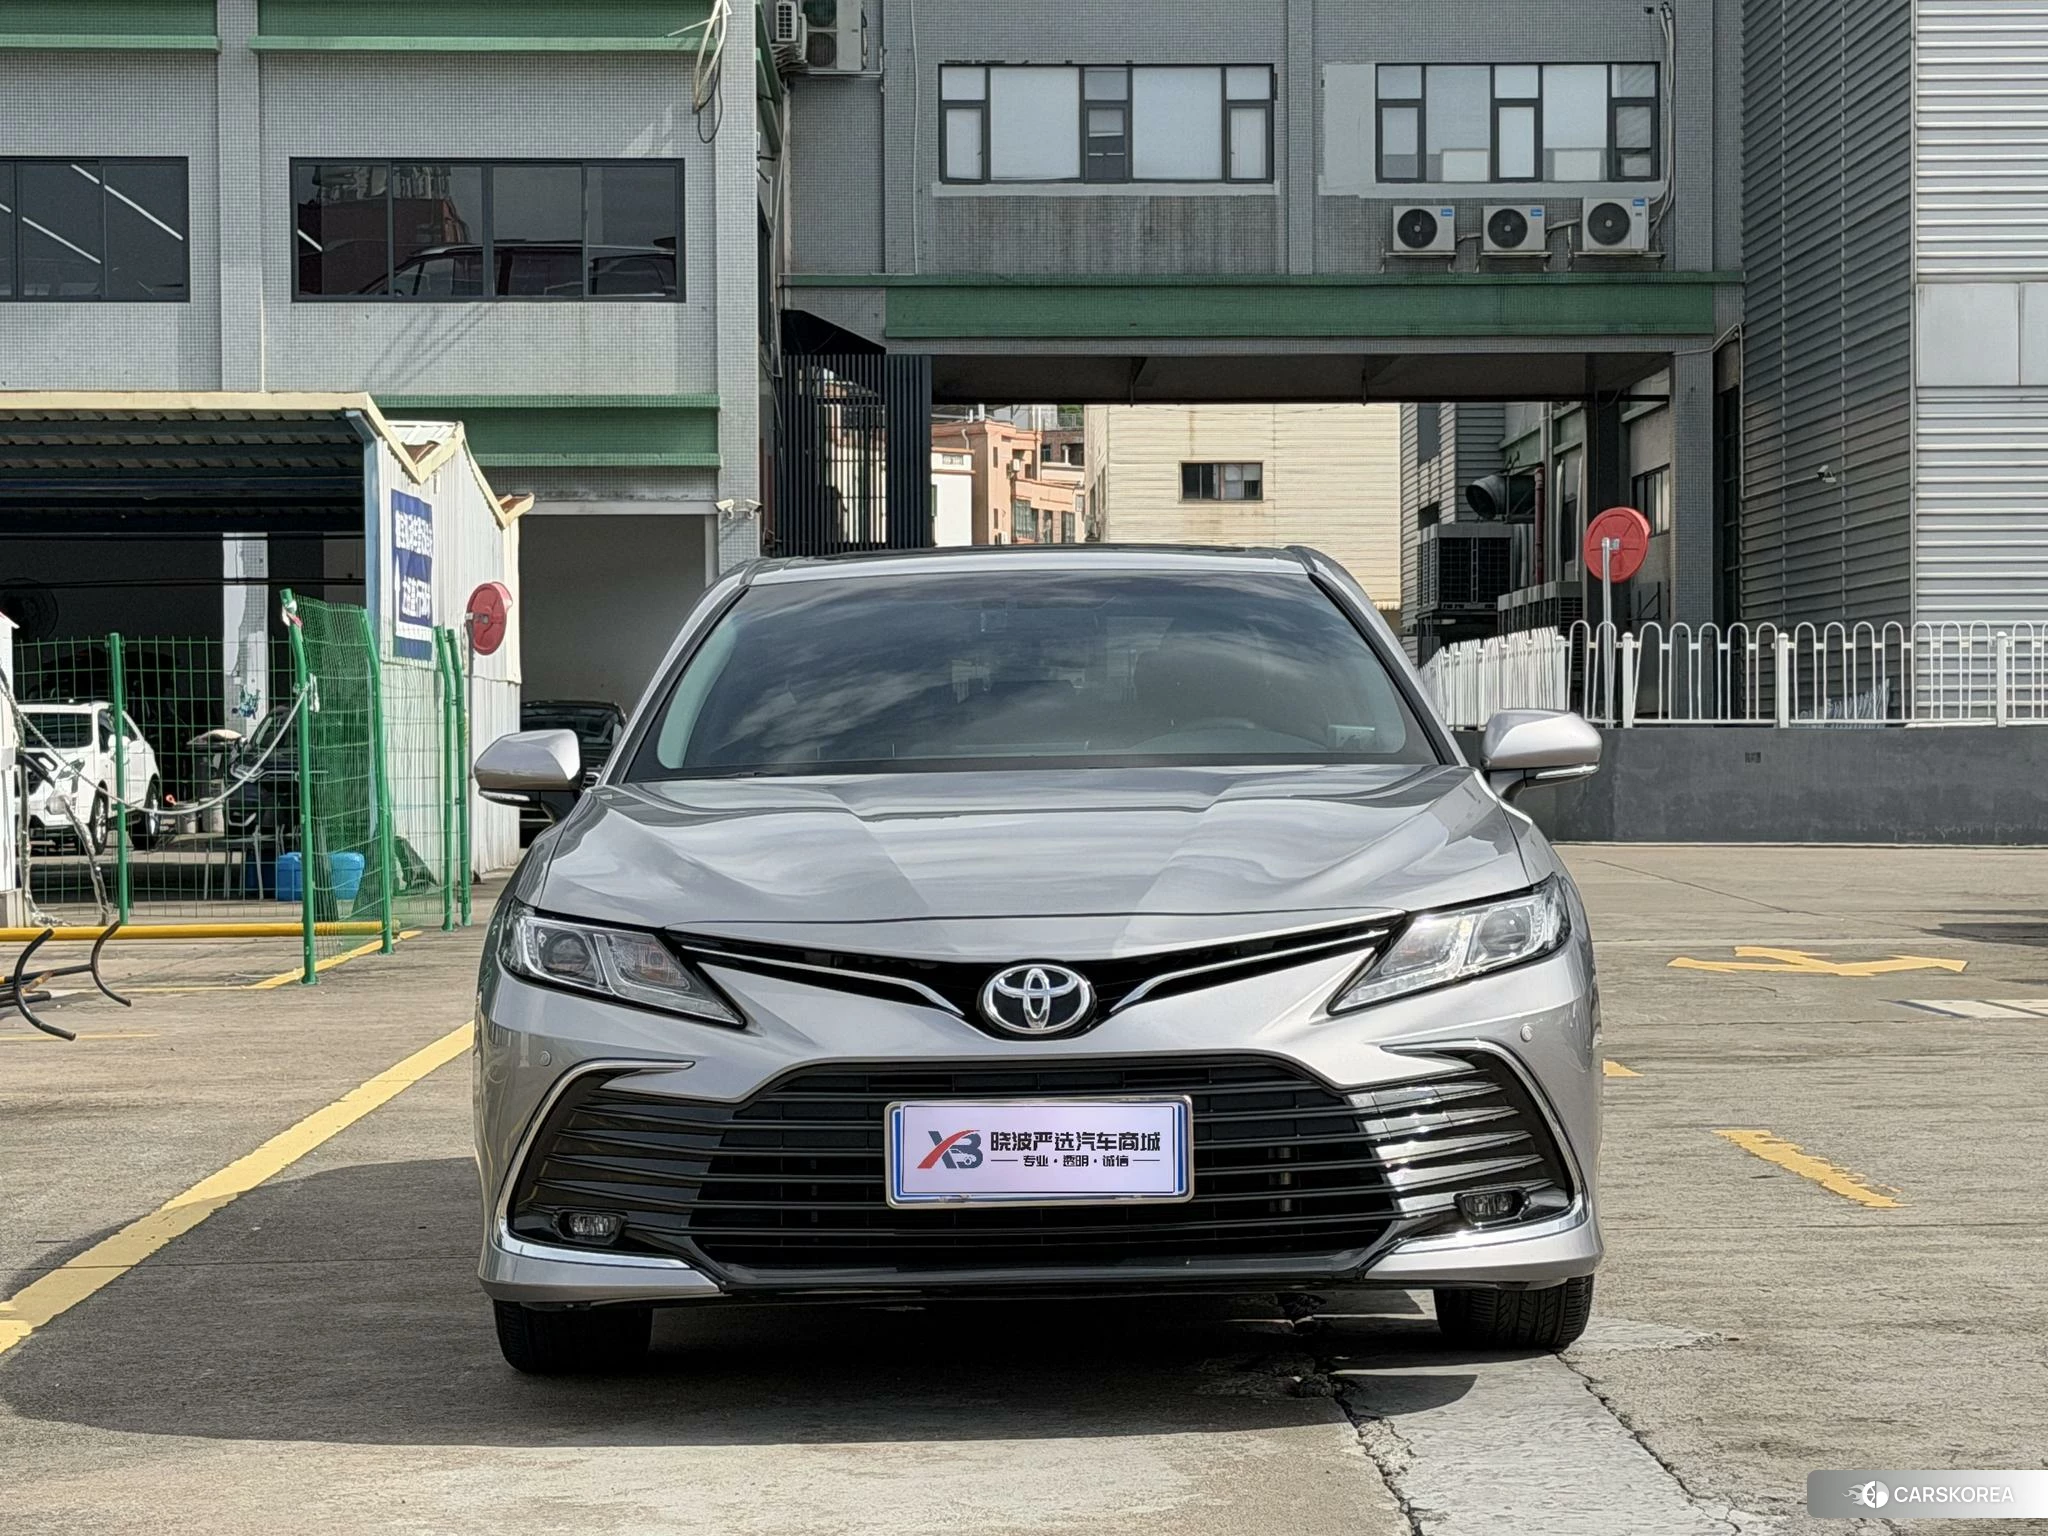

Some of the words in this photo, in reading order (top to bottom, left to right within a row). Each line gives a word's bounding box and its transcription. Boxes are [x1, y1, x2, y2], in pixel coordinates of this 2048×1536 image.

[990, 1131, 1161, 1152] 晓波严选汽车商城
